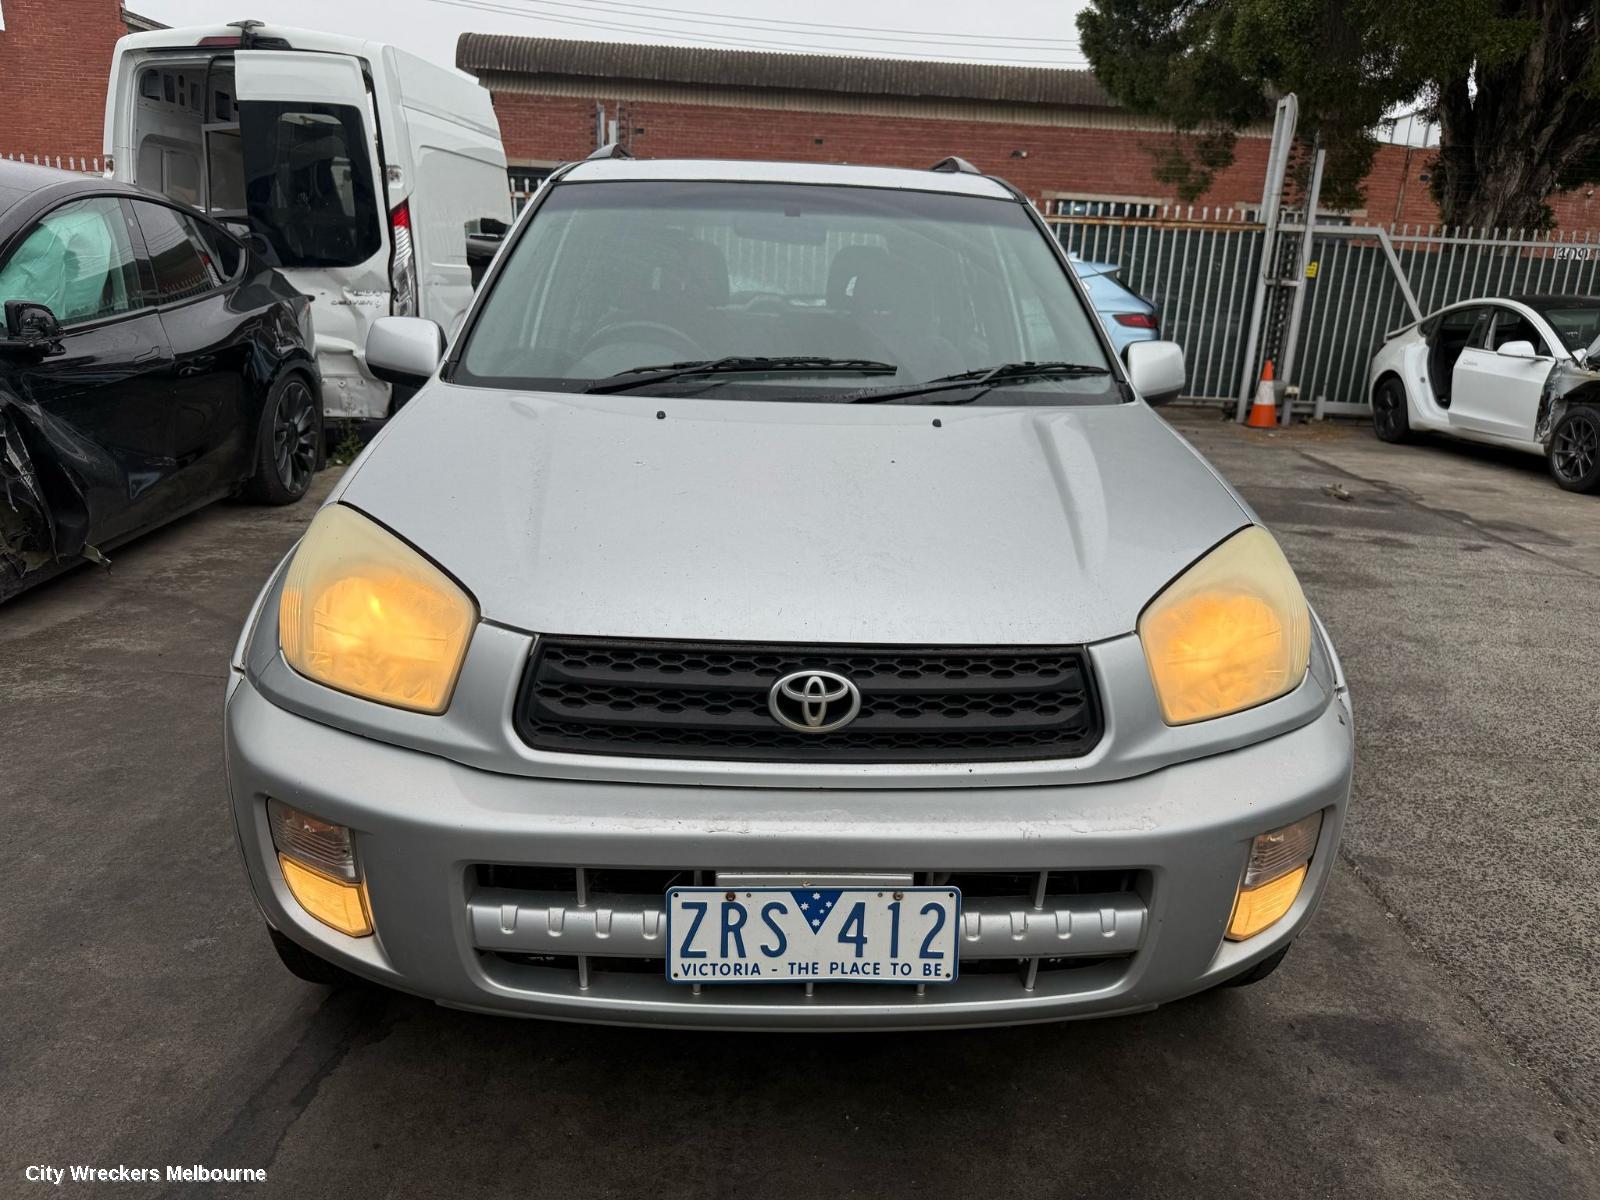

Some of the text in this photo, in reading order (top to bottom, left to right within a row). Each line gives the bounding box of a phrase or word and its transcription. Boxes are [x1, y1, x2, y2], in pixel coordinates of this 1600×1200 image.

[680, 901, 946, 959] ZRS 412
[681, 963, 761, 976] VICTORIA
[788, 962, 819, 975] THE
[829, 962, 881, 975] PLACE
[890, 963, 912, 975] TO
[923, 963, 942, 976] BE
